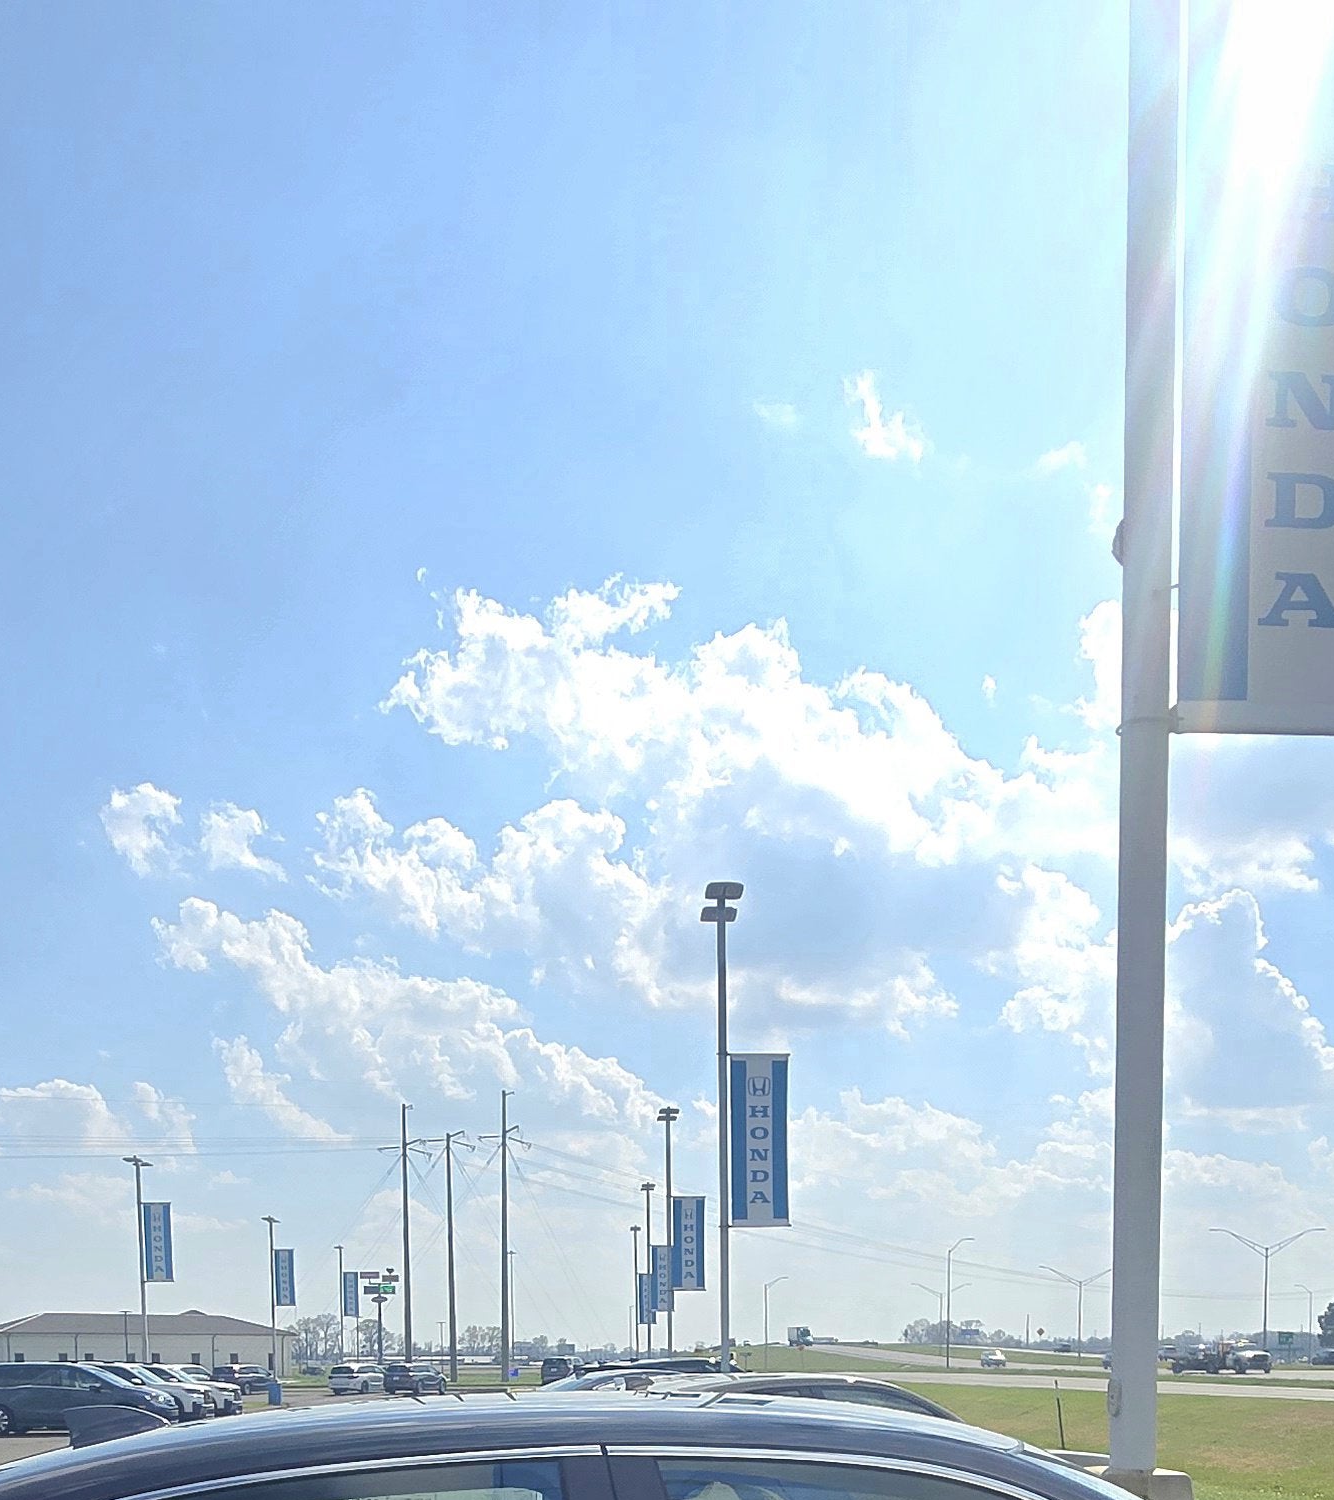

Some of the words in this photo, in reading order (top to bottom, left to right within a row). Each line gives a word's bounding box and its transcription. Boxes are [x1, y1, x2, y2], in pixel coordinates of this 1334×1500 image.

[749, 1105, 771, 1203] HONDA
[152, 1225, 165, 1273] HONDA
[683, 1223, 695, 1279] HONDA
